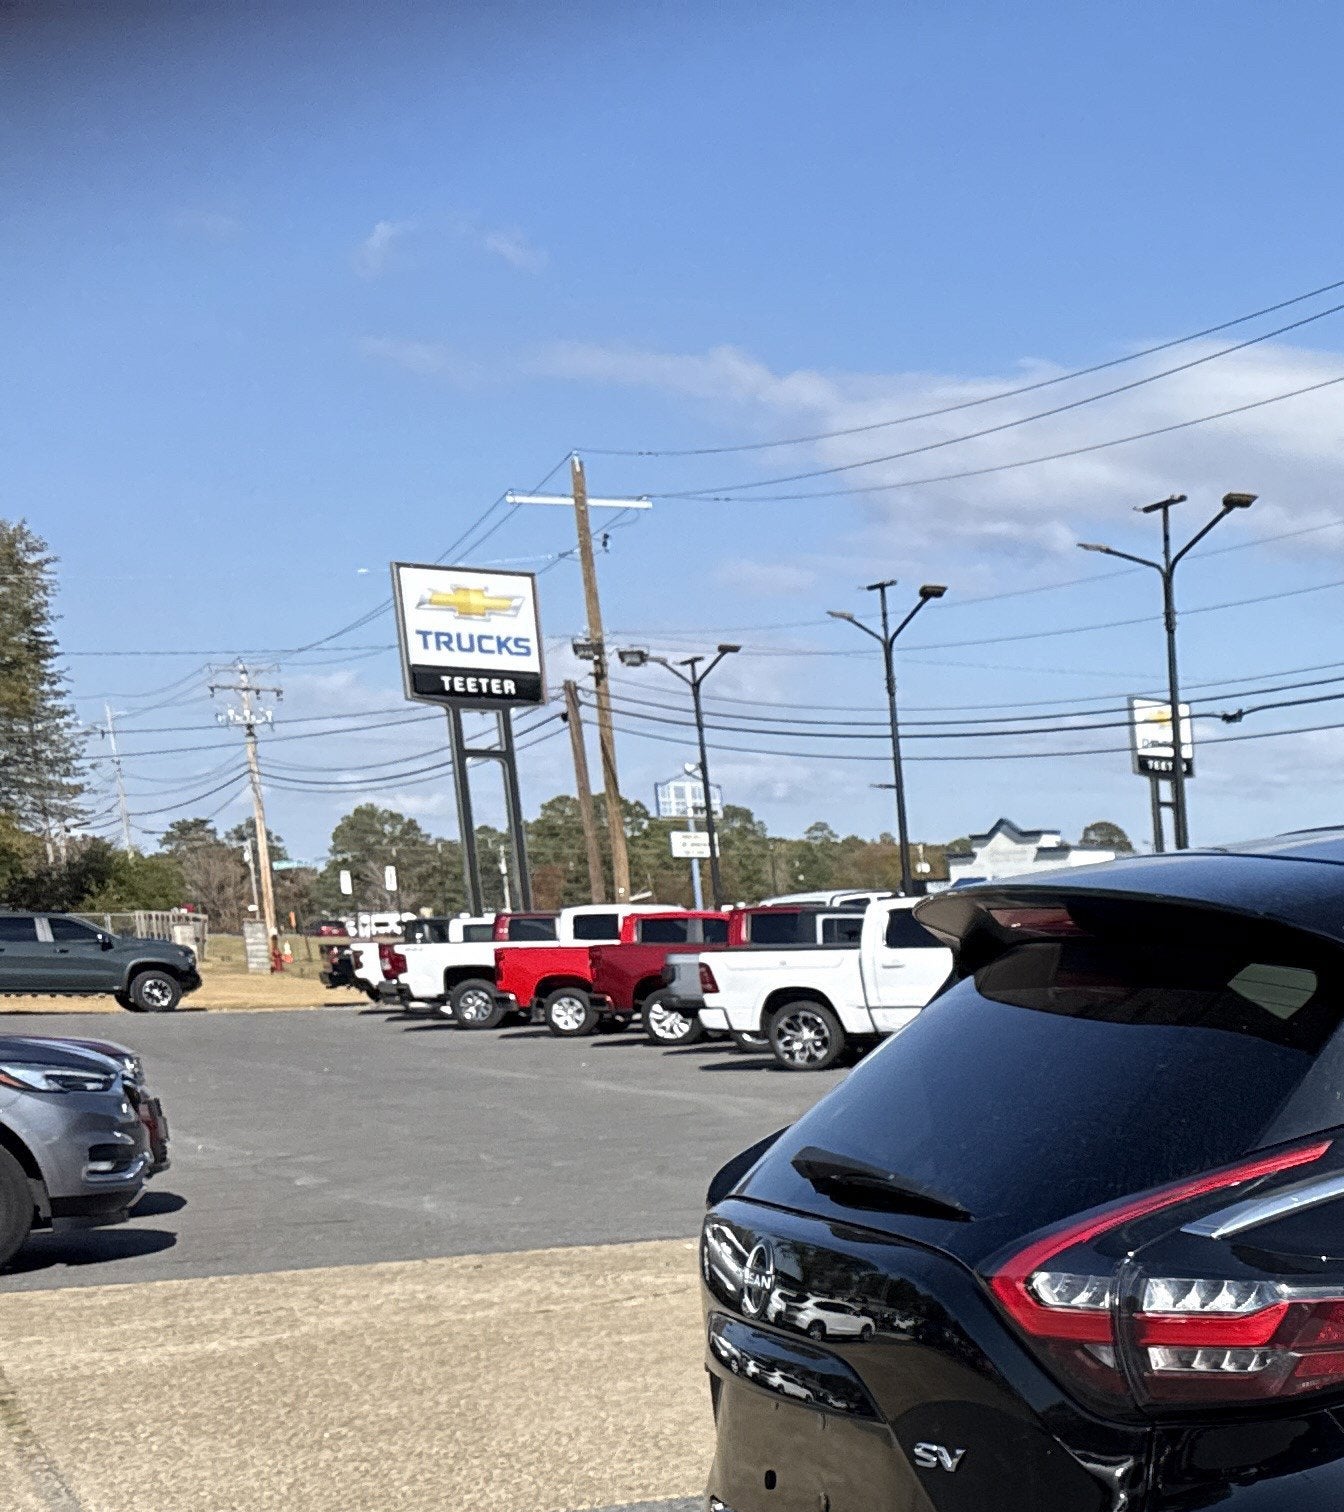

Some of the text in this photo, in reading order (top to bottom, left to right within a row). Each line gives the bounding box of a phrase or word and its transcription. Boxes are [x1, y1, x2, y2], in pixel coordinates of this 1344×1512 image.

[415, 629, 531, 657] TRUCKS
[440, 675, 516, 695] TEETER
[1147, 759, 1187, 772] TEETR
[914, 1442, 967, 1472] SV
